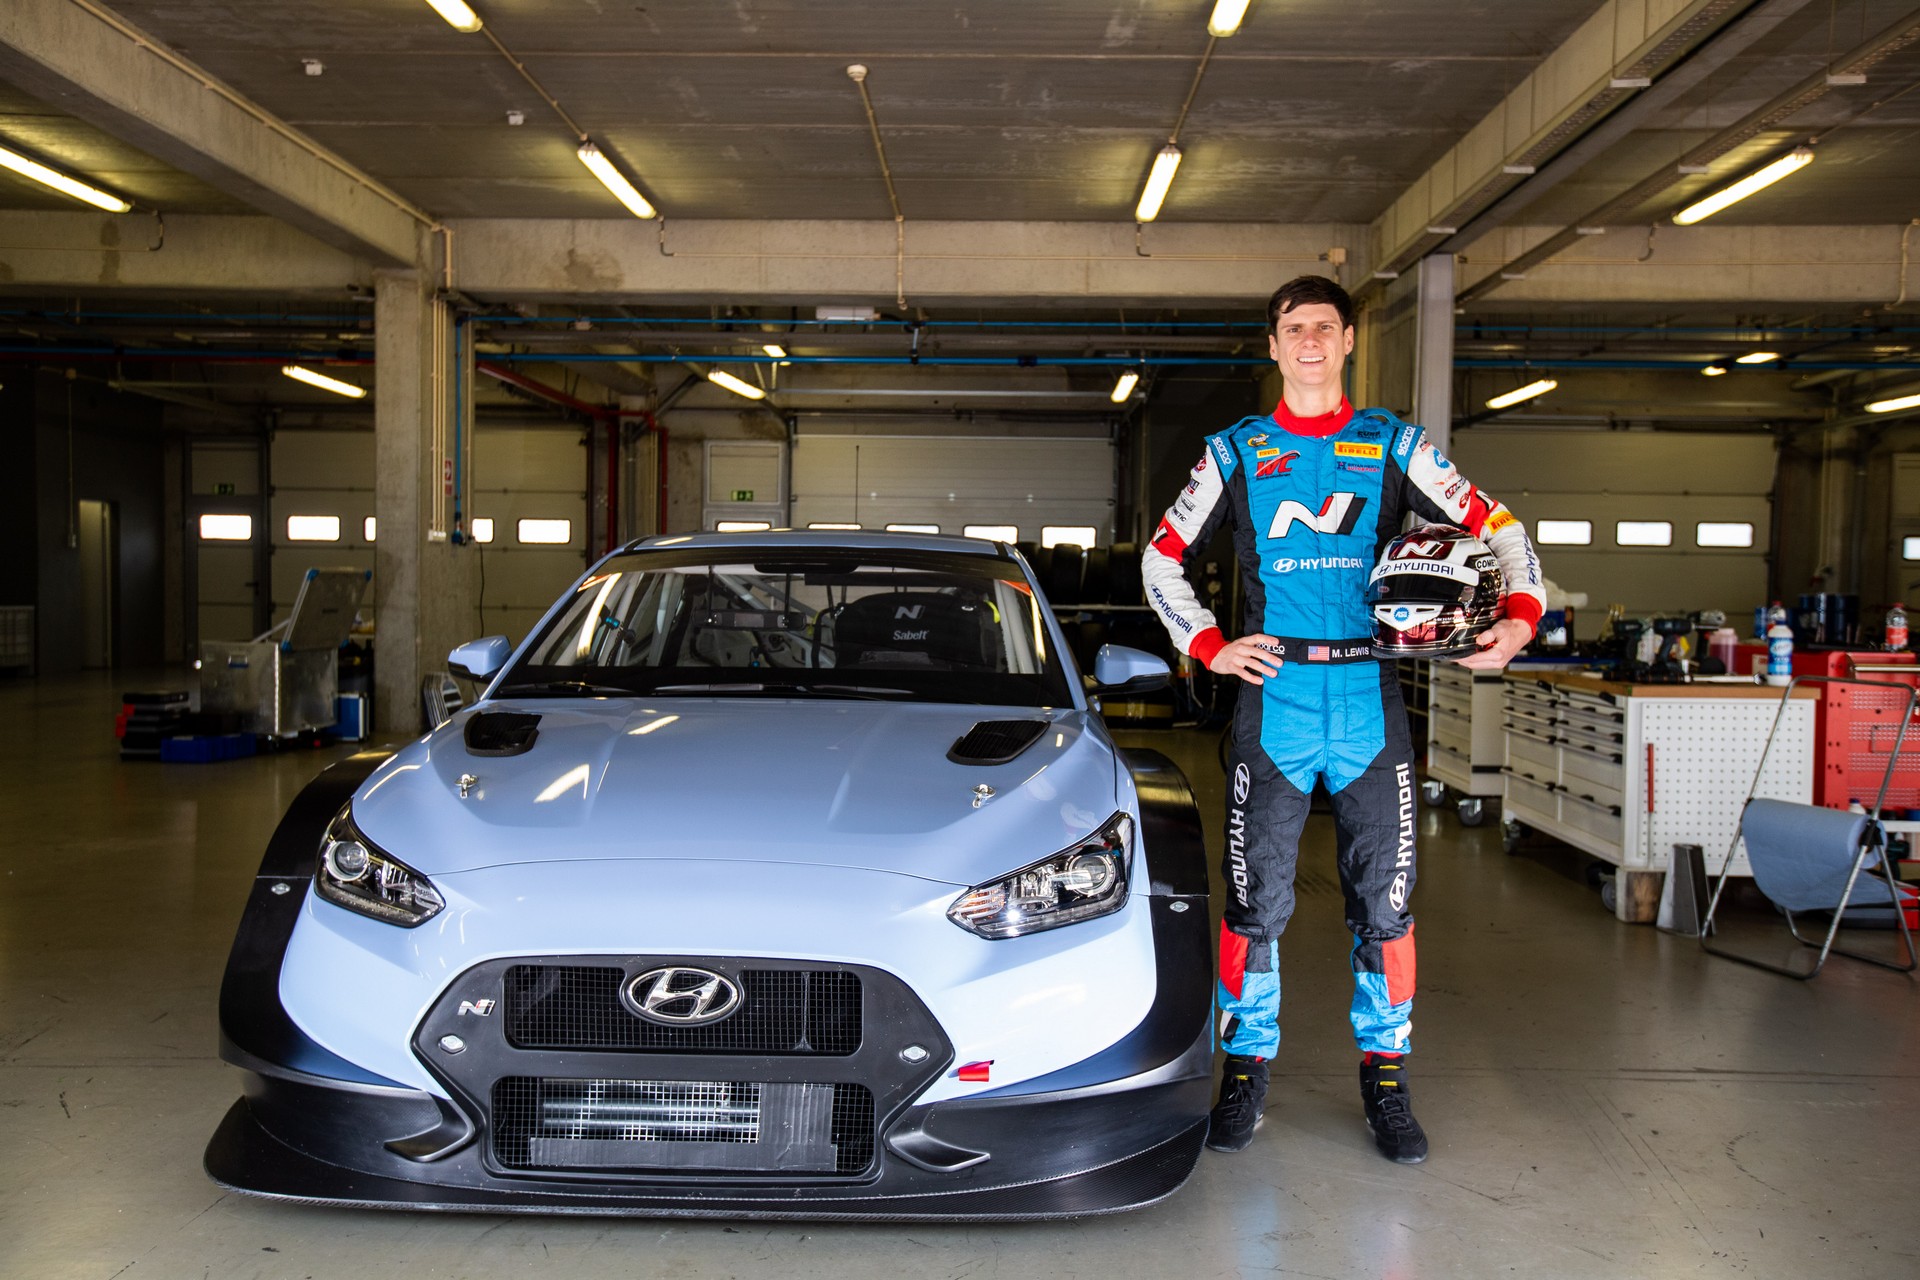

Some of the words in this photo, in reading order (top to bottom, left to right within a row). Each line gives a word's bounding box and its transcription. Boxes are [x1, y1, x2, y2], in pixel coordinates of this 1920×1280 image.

[1212, 436, 1232, 465] sparco
[1338, 444, 1378, 456] PIRELLI
[1397, 426, 1415, 456] sparco
[1300, 557, 1363, 570] HYUNDAI
[1393, 562, 1454, 576] HYUNDAI
[1159, 597, 1193, 633] HYUNDAI
[893, 630, 928, 640] Sabelt
[1331, 648, 1343, 658] M.
[1345, 647, 1369, 657] LEWIS
[1395, 762, 1414, 867] HYUNDAI
[1229, 808, 1249, 908] HYUNDAI
